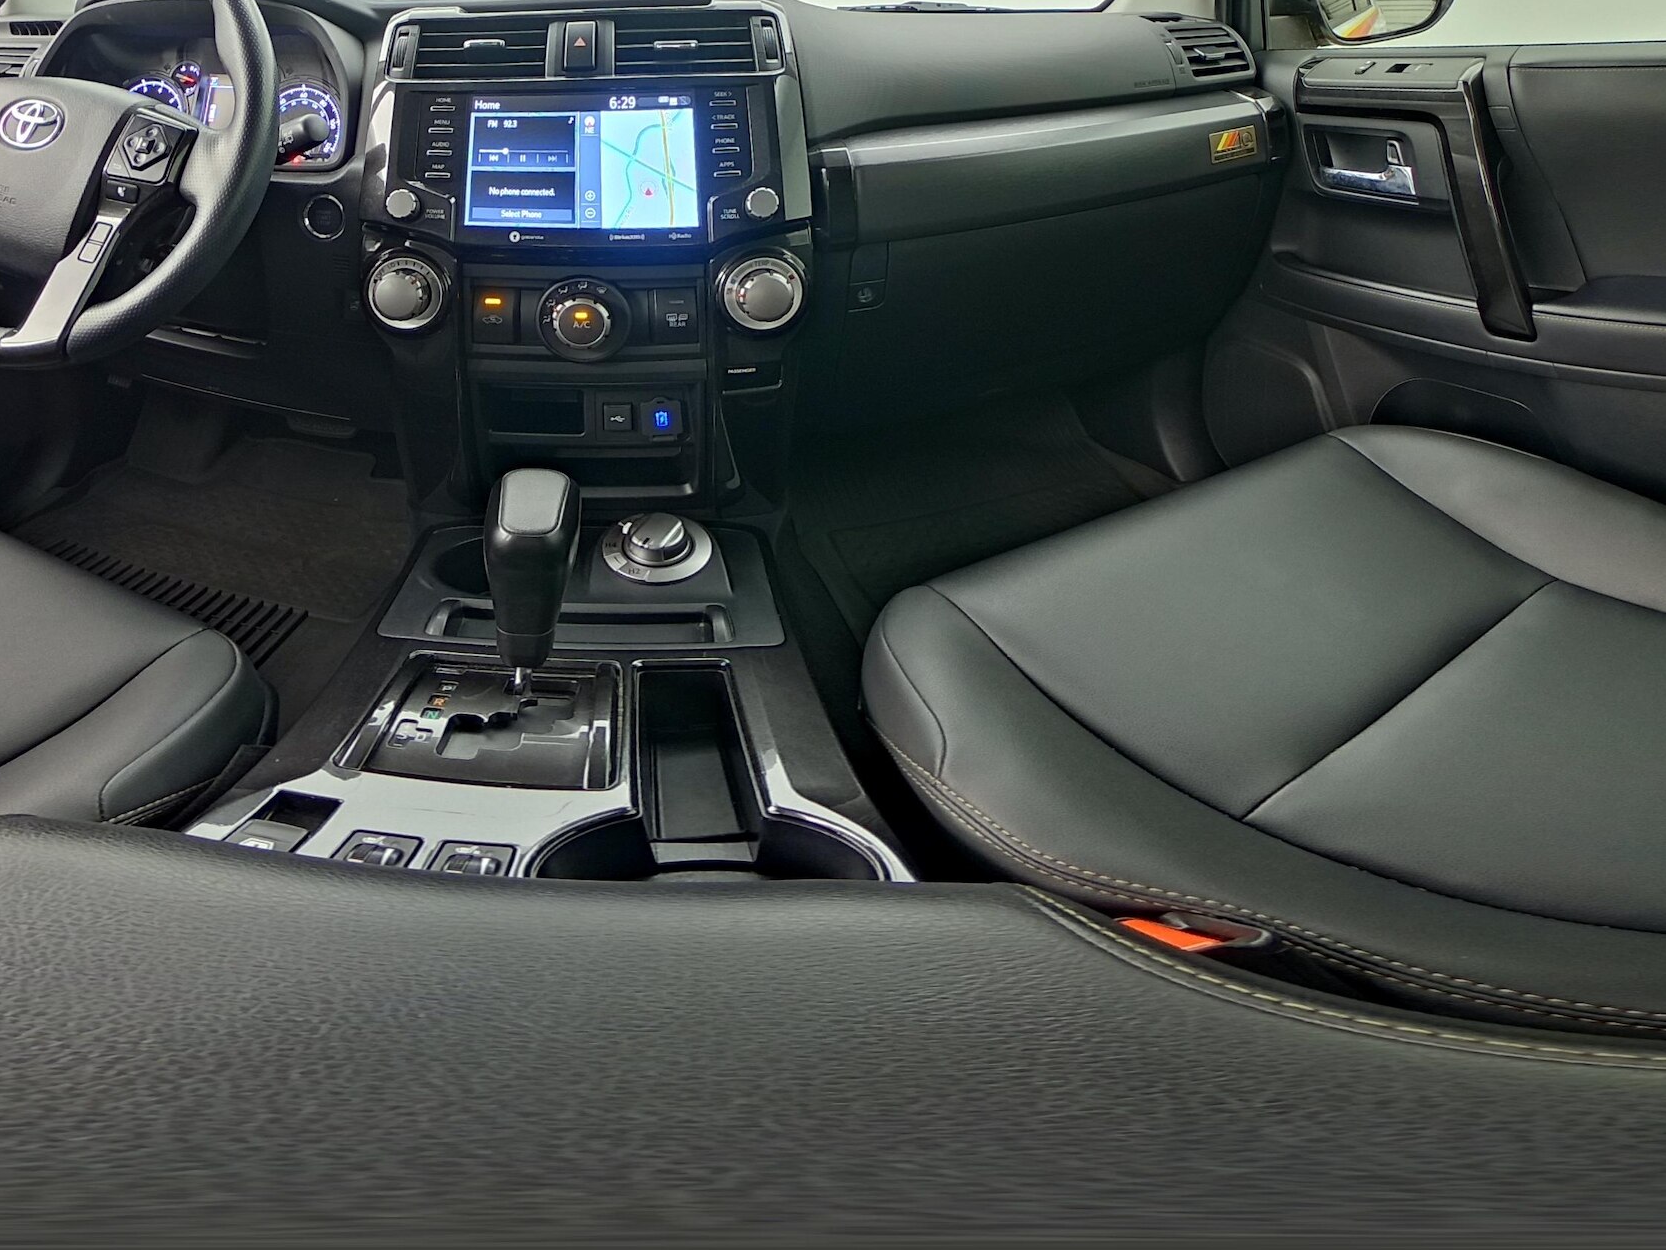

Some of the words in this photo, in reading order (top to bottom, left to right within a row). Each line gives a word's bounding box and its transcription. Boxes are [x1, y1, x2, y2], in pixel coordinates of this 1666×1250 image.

[474, 100, 501, 110] Home
[609, 97, 636, 110] 6:29
[487, 120, 498, 128] FM
[503, 120, 518, 128] 92.3
[488, 186, 499, 196] No
[499, 187, 520, 197] phone
[520, 188, 556, 197] connected.
[500, 209, 521, 218] Select
[521, 210, 542, 219] Phone
[573, 320, 591, 329] A/C
[433, 697, 446, 707] R
[426, 710, 439, 719] N
